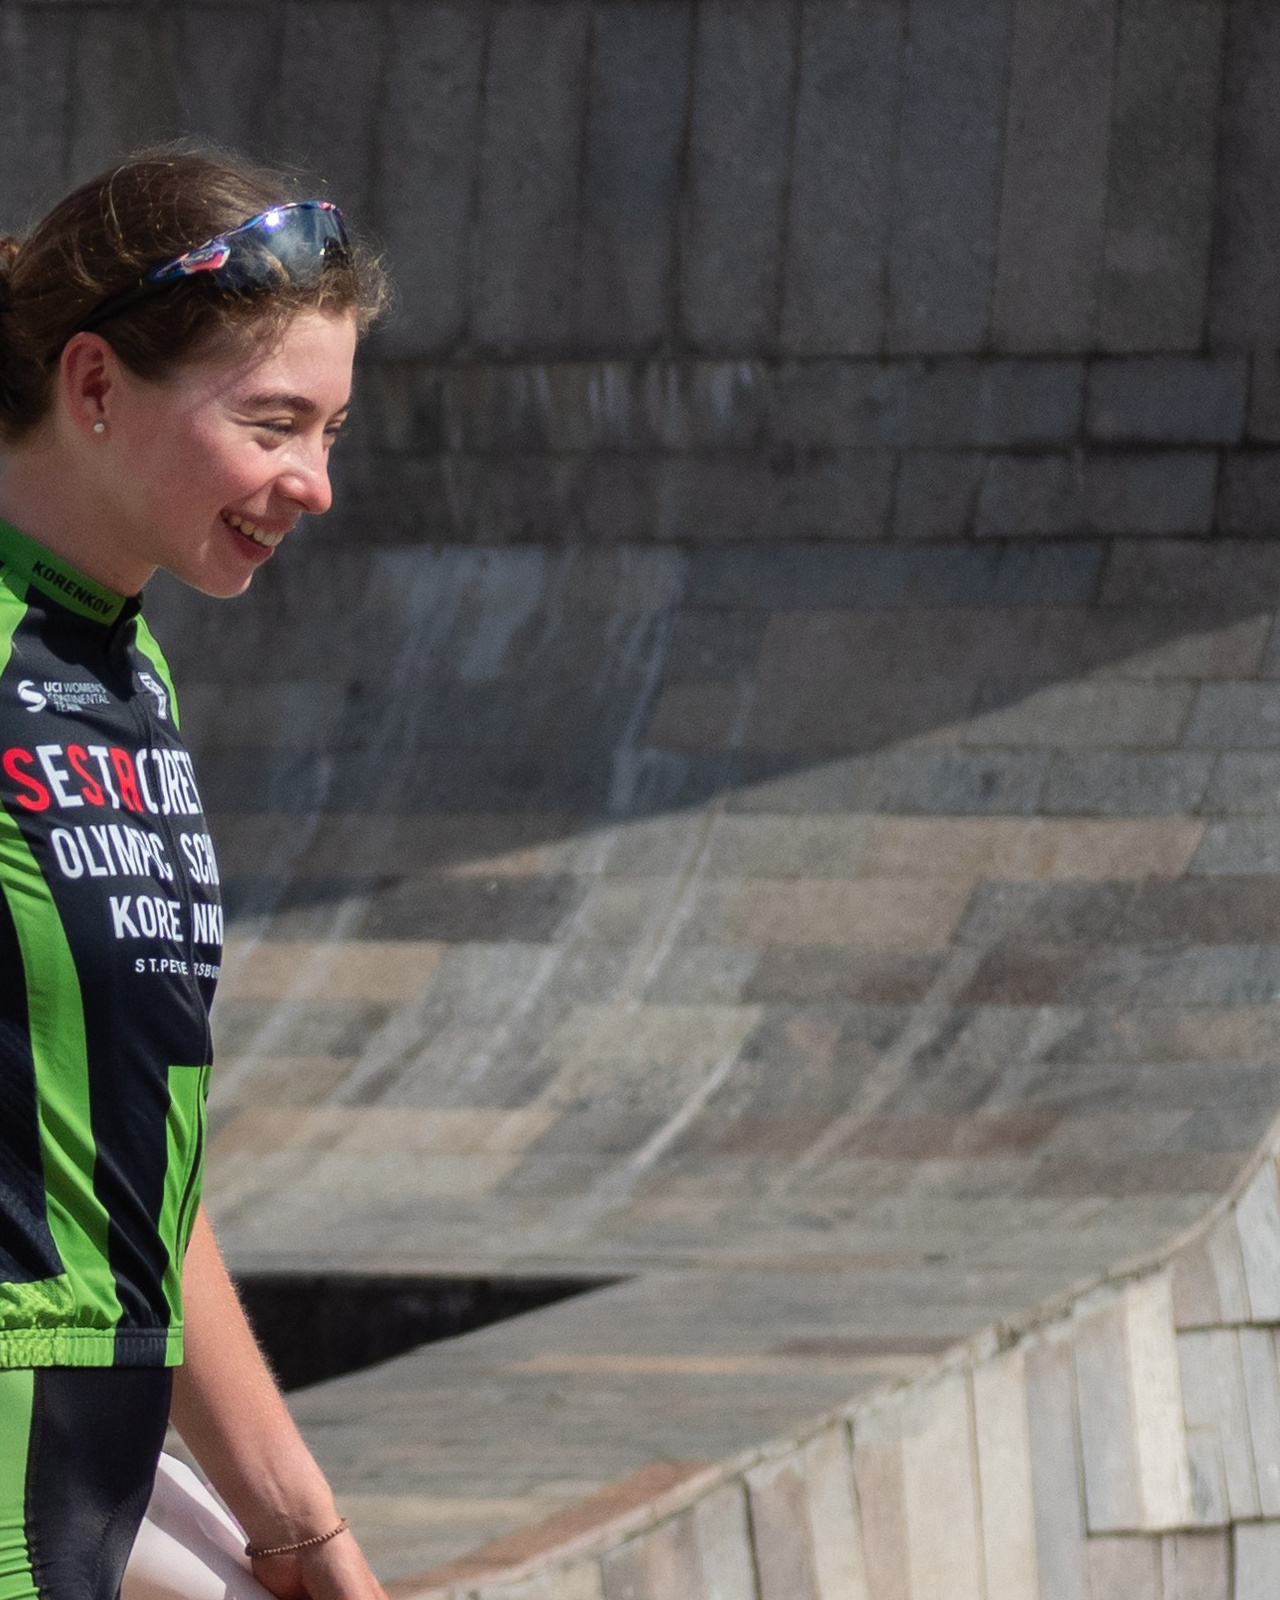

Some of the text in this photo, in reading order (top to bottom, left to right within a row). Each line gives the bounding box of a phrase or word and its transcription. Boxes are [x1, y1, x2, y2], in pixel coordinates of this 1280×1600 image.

[31, 560, 115, 616] KORENKOV
[43, 681, 62, 693] UCI
[51, 823, 220, 886] OLYMPIC SCH
